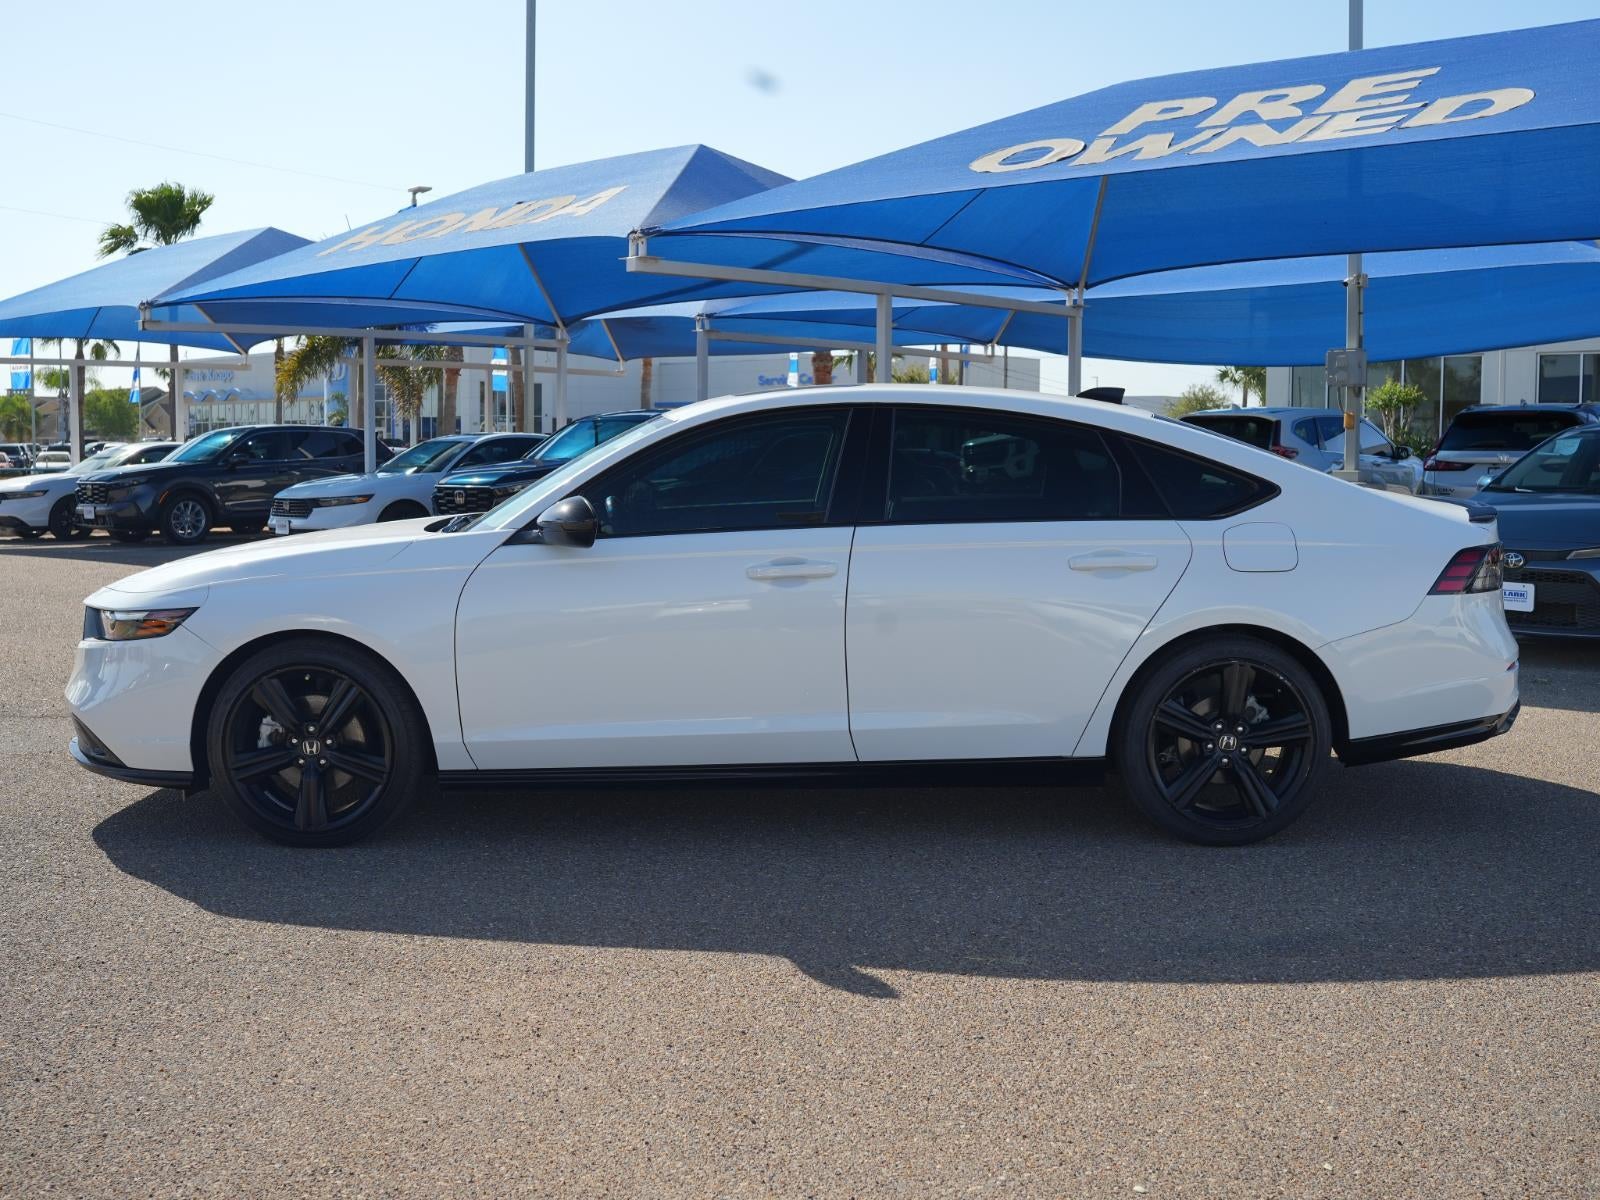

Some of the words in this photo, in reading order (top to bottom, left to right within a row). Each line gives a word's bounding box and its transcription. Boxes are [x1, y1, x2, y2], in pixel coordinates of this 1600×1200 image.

[968, 88, 1535, 172] OWNED
[1099, 66, 1441, 136] PRE
[316, 185, 628, 257] HONDA
